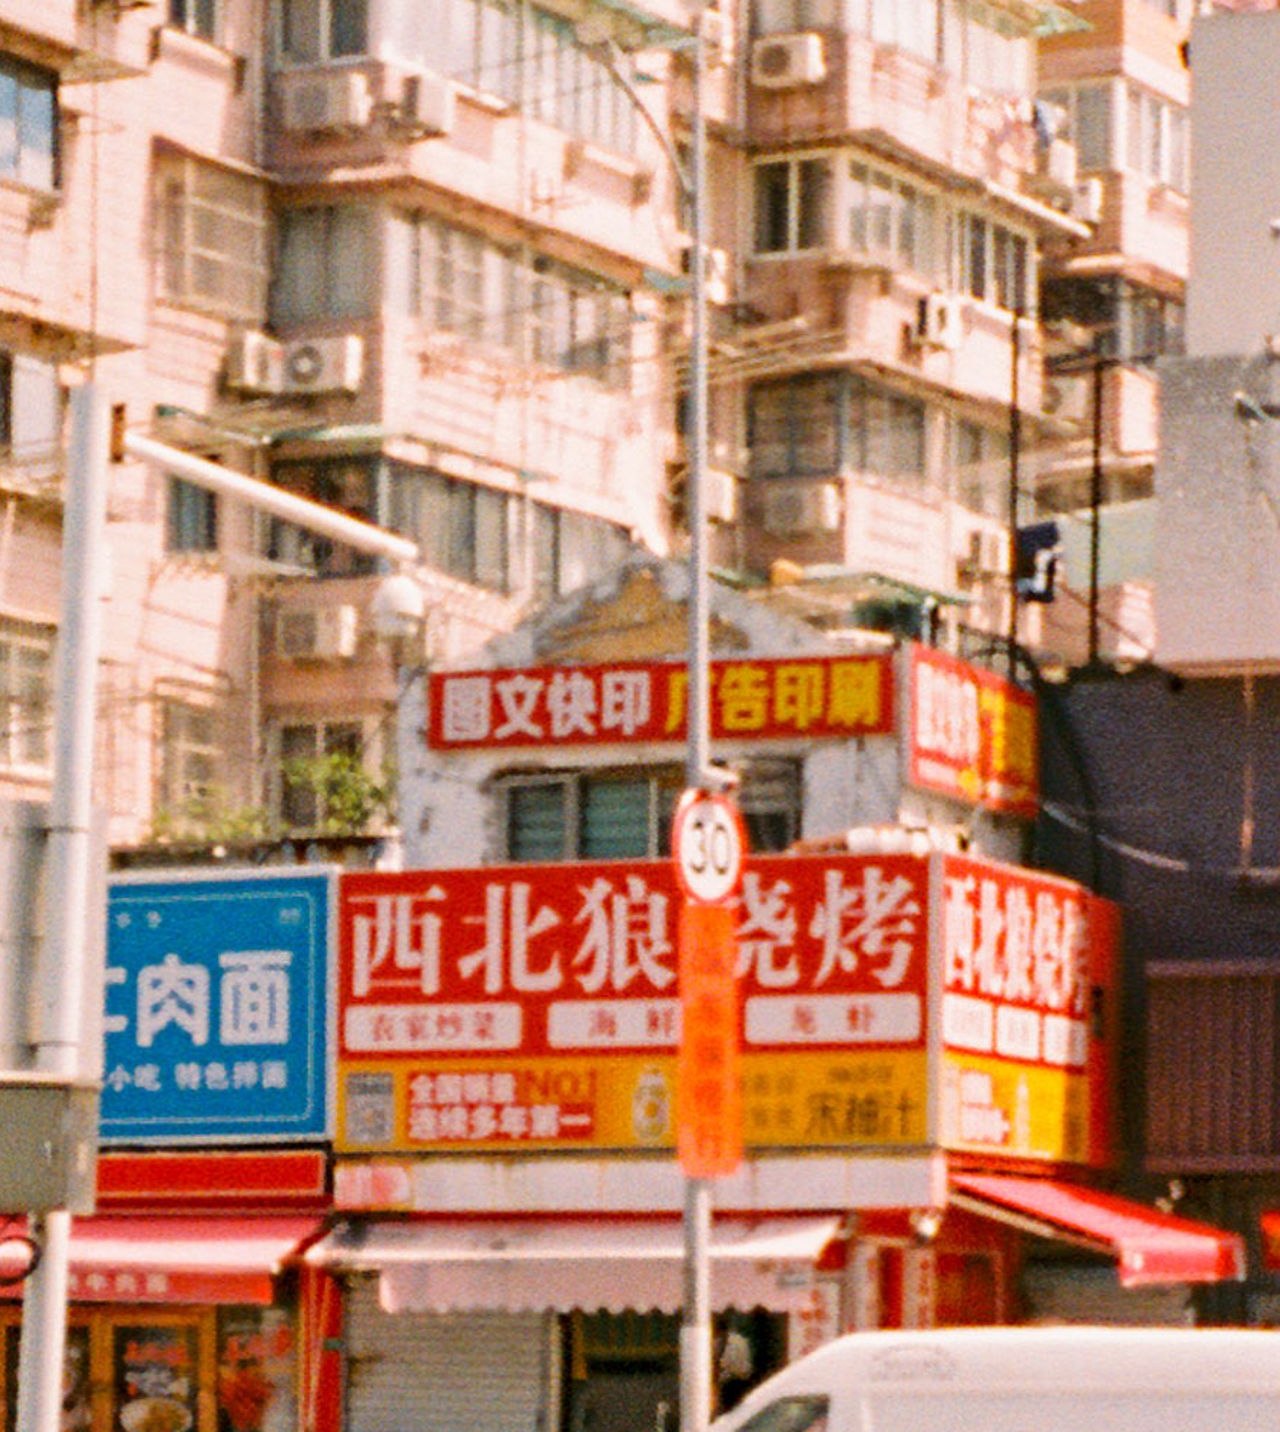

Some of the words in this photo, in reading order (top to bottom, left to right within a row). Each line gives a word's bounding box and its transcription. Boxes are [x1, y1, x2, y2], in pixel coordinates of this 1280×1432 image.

[442, 671, 650, 742] 图文快印
[666, 661, 881, 733] 广告印刷
[692, 820, 731, 875] 30
[347, 867, 921, 997] 西北狼烧烤
